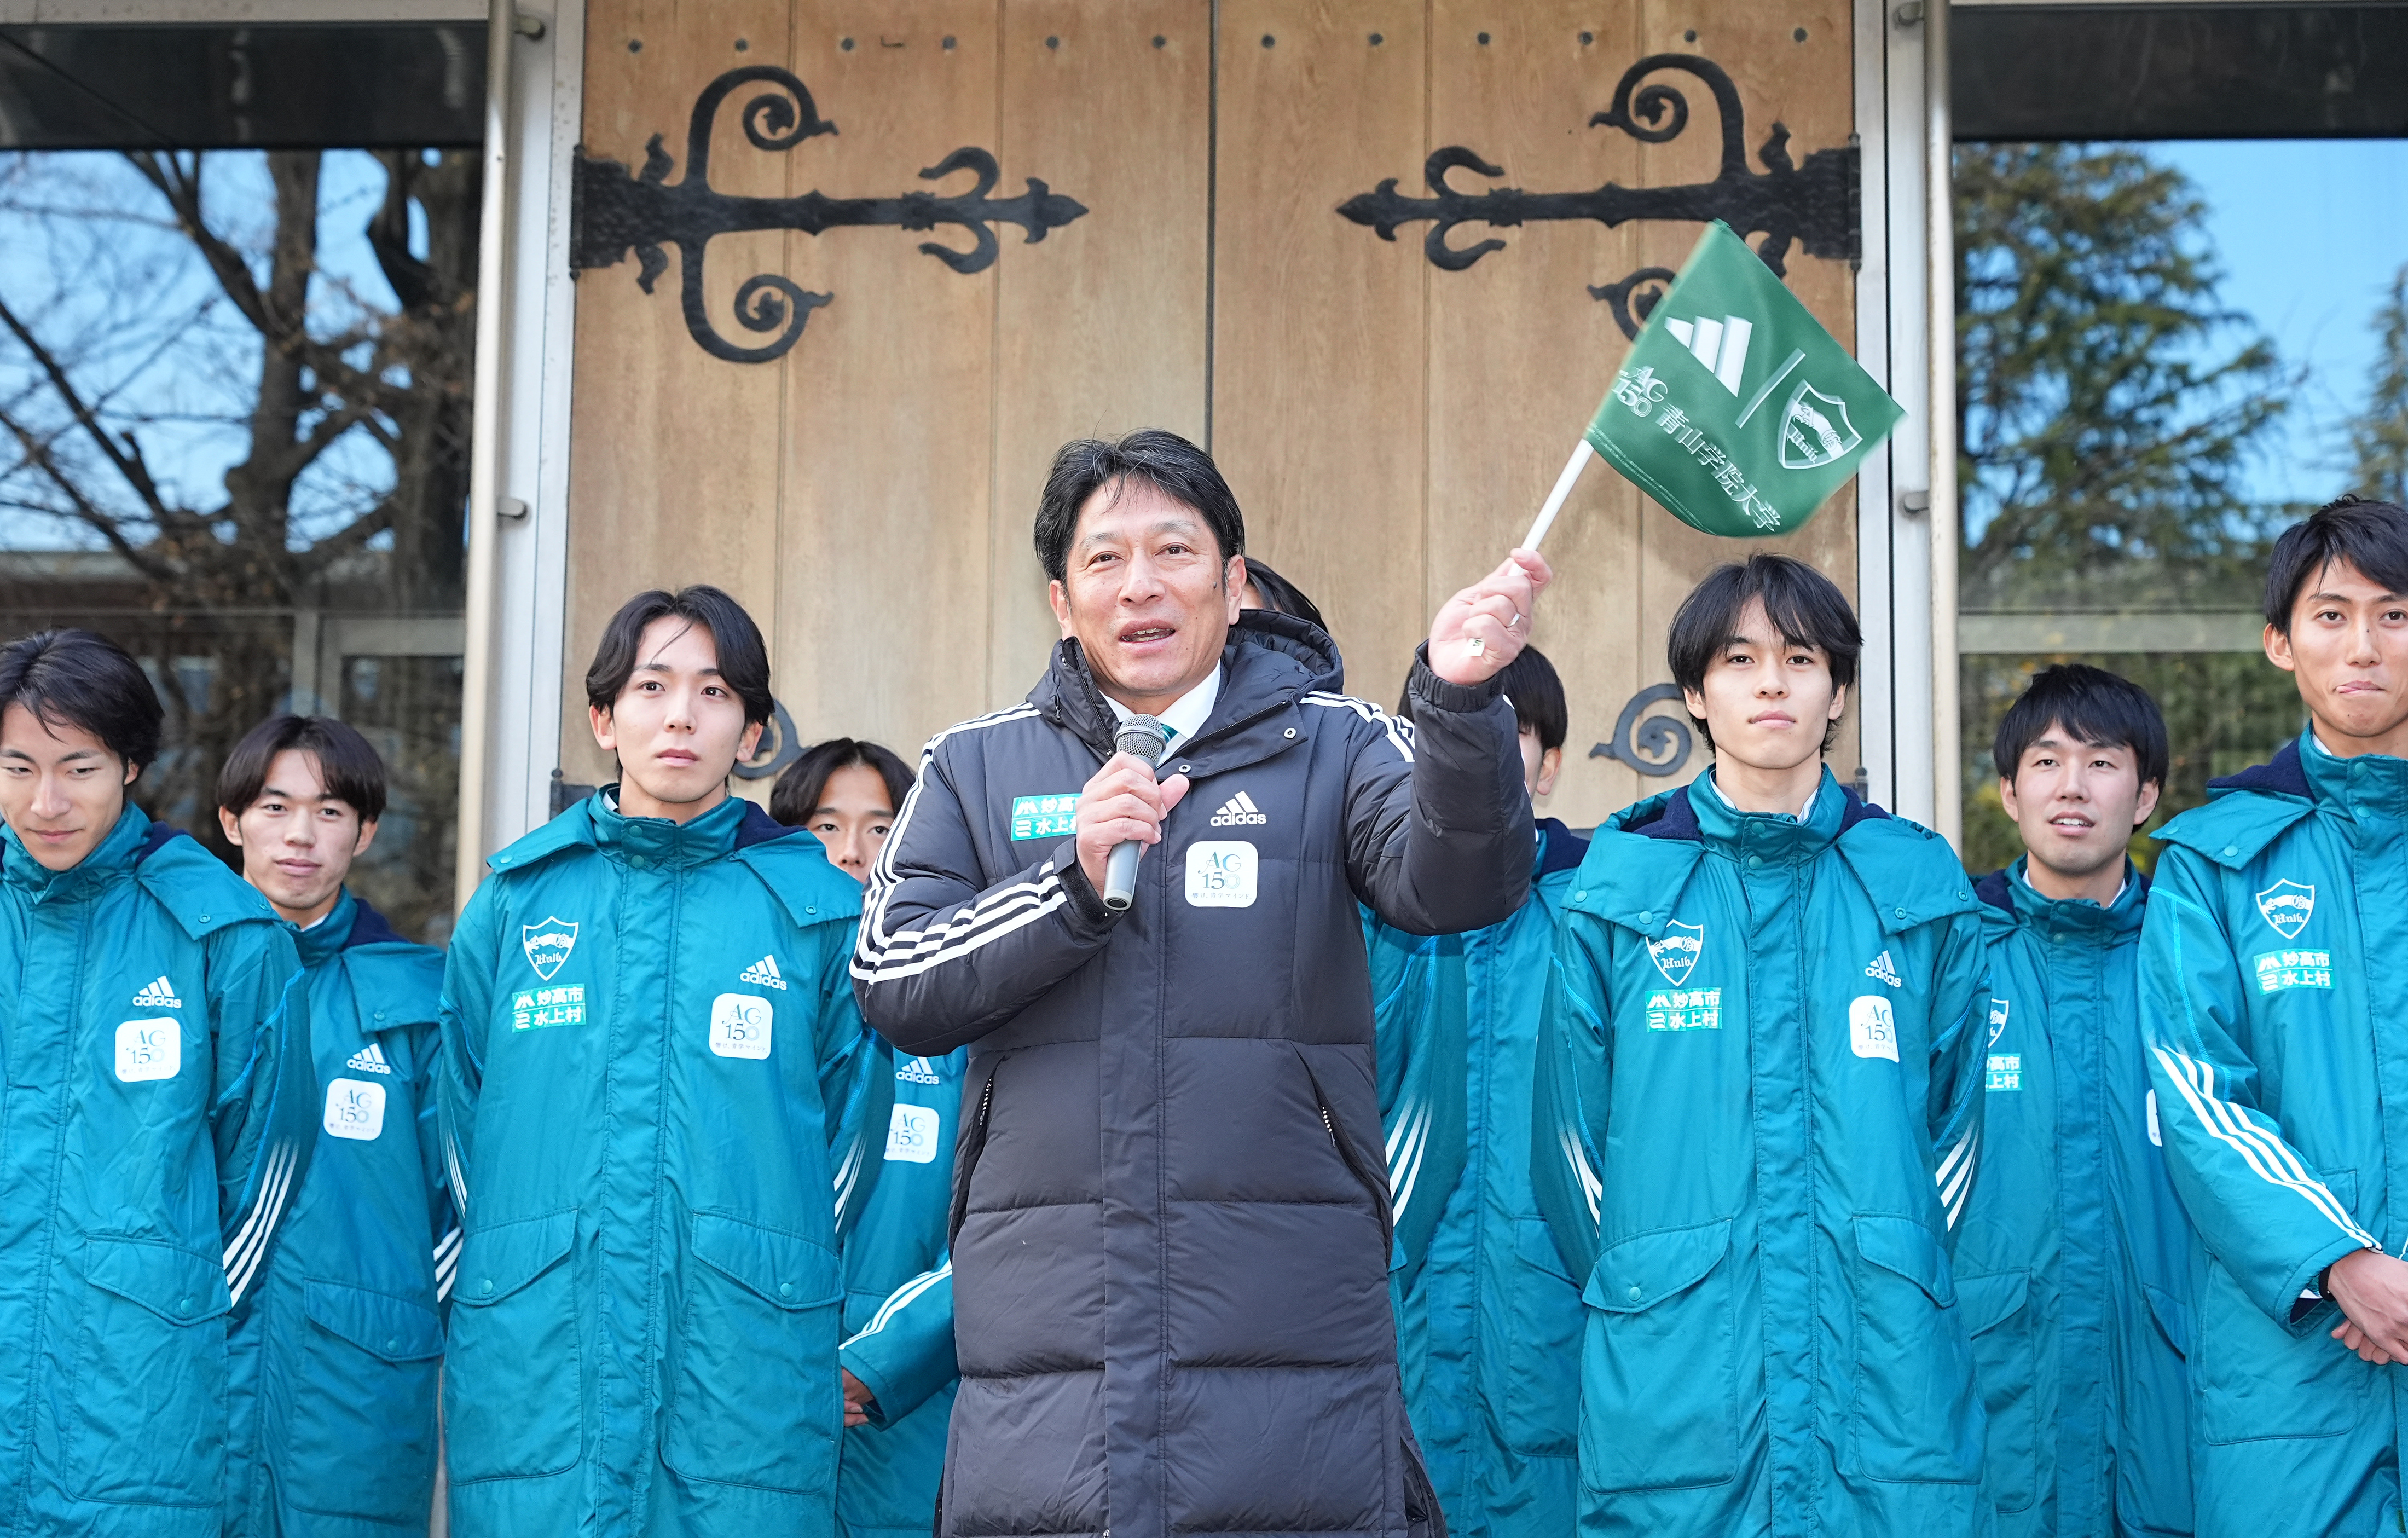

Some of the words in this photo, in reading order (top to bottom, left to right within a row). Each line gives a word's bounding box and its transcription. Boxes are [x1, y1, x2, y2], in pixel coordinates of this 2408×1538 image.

[1656, 402, 1781, 532] 青山学院大学
[1040, 796, 1079, 813] 妙高
[1210, 812, 1267, 827] adidas
[1197, 851, 1242, 874] AG
[1202, 870, 1241, 889] 150
[2282, 951, 2330, 968] 妙高市
[739, 972, 787, 990] adidas
[1865, 967, 1902, 988] adidas
[2282, 970, 2331, 987] 水上村
[132, 994, 182, 1009] adidas
[536, 986, 583, 1006] 妙高市
[1673, 990, 1721, 1009] 妙高市
[534, 1006, 582, 1026] 水上村
[721, 1003, 762, 1025] AG
[1670, 1010, 1719, 1029] 水上村
[725, 1021, 760, 1041] 150
[1865, 1023, 1894, 1043] 150
[130, 1046, 165, 1064] 150
[1987, 1055, 2020, 1071] 高市
[346, 1059, 391, 1074] adidas
[895, 1069, 940, 1085] adidas
[1985, 1073, 2019, 1089] 上村
